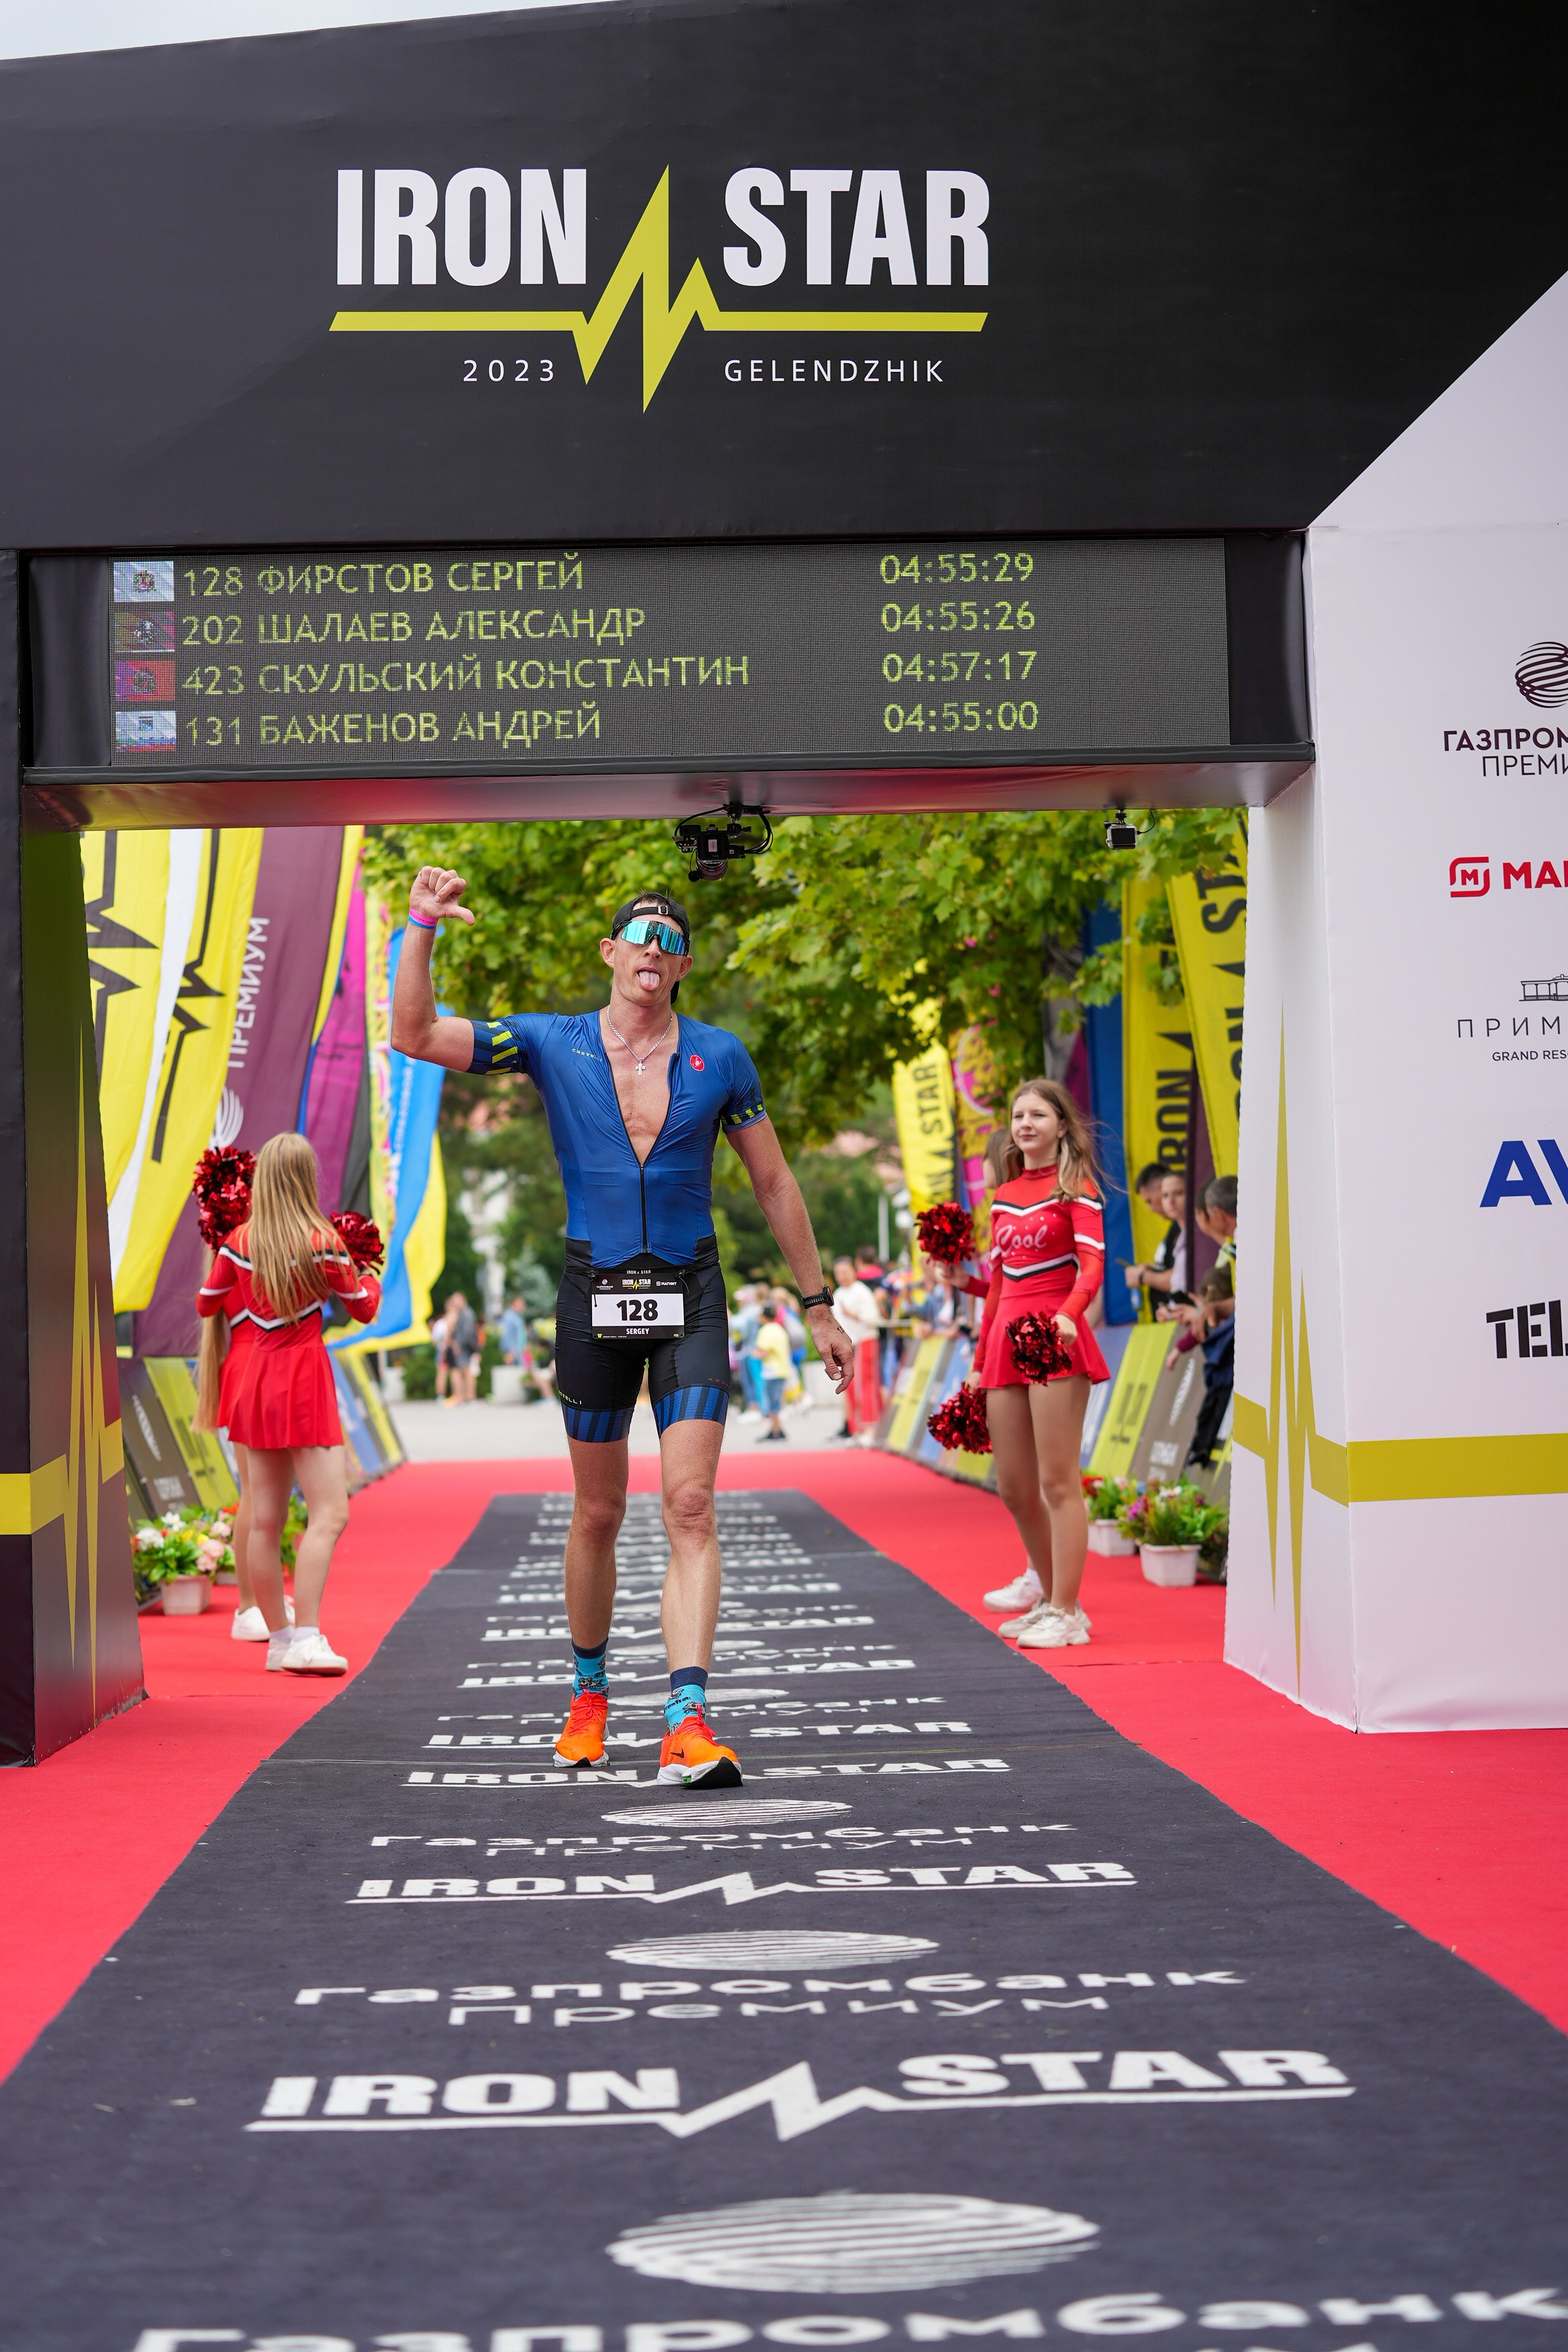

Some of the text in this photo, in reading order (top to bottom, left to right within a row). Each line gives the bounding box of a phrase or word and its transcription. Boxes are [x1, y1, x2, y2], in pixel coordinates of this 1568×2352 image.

[336, 167, 989, 287] IRON STAR
[463, 359, 944, 383] 2023 GELENDZHIK
[183, 552, 1034, 596] 128 ФИРСТОВ СЕРГЕЙ 04:55:29
[182, 601, 1036, 646] 202 ШАЛАЕВ АЛЕКСАНДР 04:55:26
[182, 650, 1037, 695] 423 СКУЛЬСКИЙ КОНСТАНТИН 04:57:17
[185, 701, 1038, 748] 131 БАЖЕНОВ АНДРЕЙ 04:55:00
[226, 917, 271, 1069] ПРЕМИУМ
[1457, 1016, 1561, 1038] ПРИМ
[1492, 1049, 1568, 1061] GRAND RES
[913, 1063, 944, 1136] STAR
[995, 1224, 1048, 1259] Cool
[616, 1299, 658, 1321] 128
[749, 1721, 972, 1737] STAR
[408, 1759, 1010, 1784] IRON STAR
[370, 1824, 1078, 1847] Газпромбанк
[484, 1838, 974, 1857] Премиум
[357, 1862, 1135, 1898] IRON STAR
[293, 1971, 1246, 2005] Газпромбанк
[447, 1996, 1111, 2027] Премиум
[260, 2050, 1349, 2116] IRON STAR
